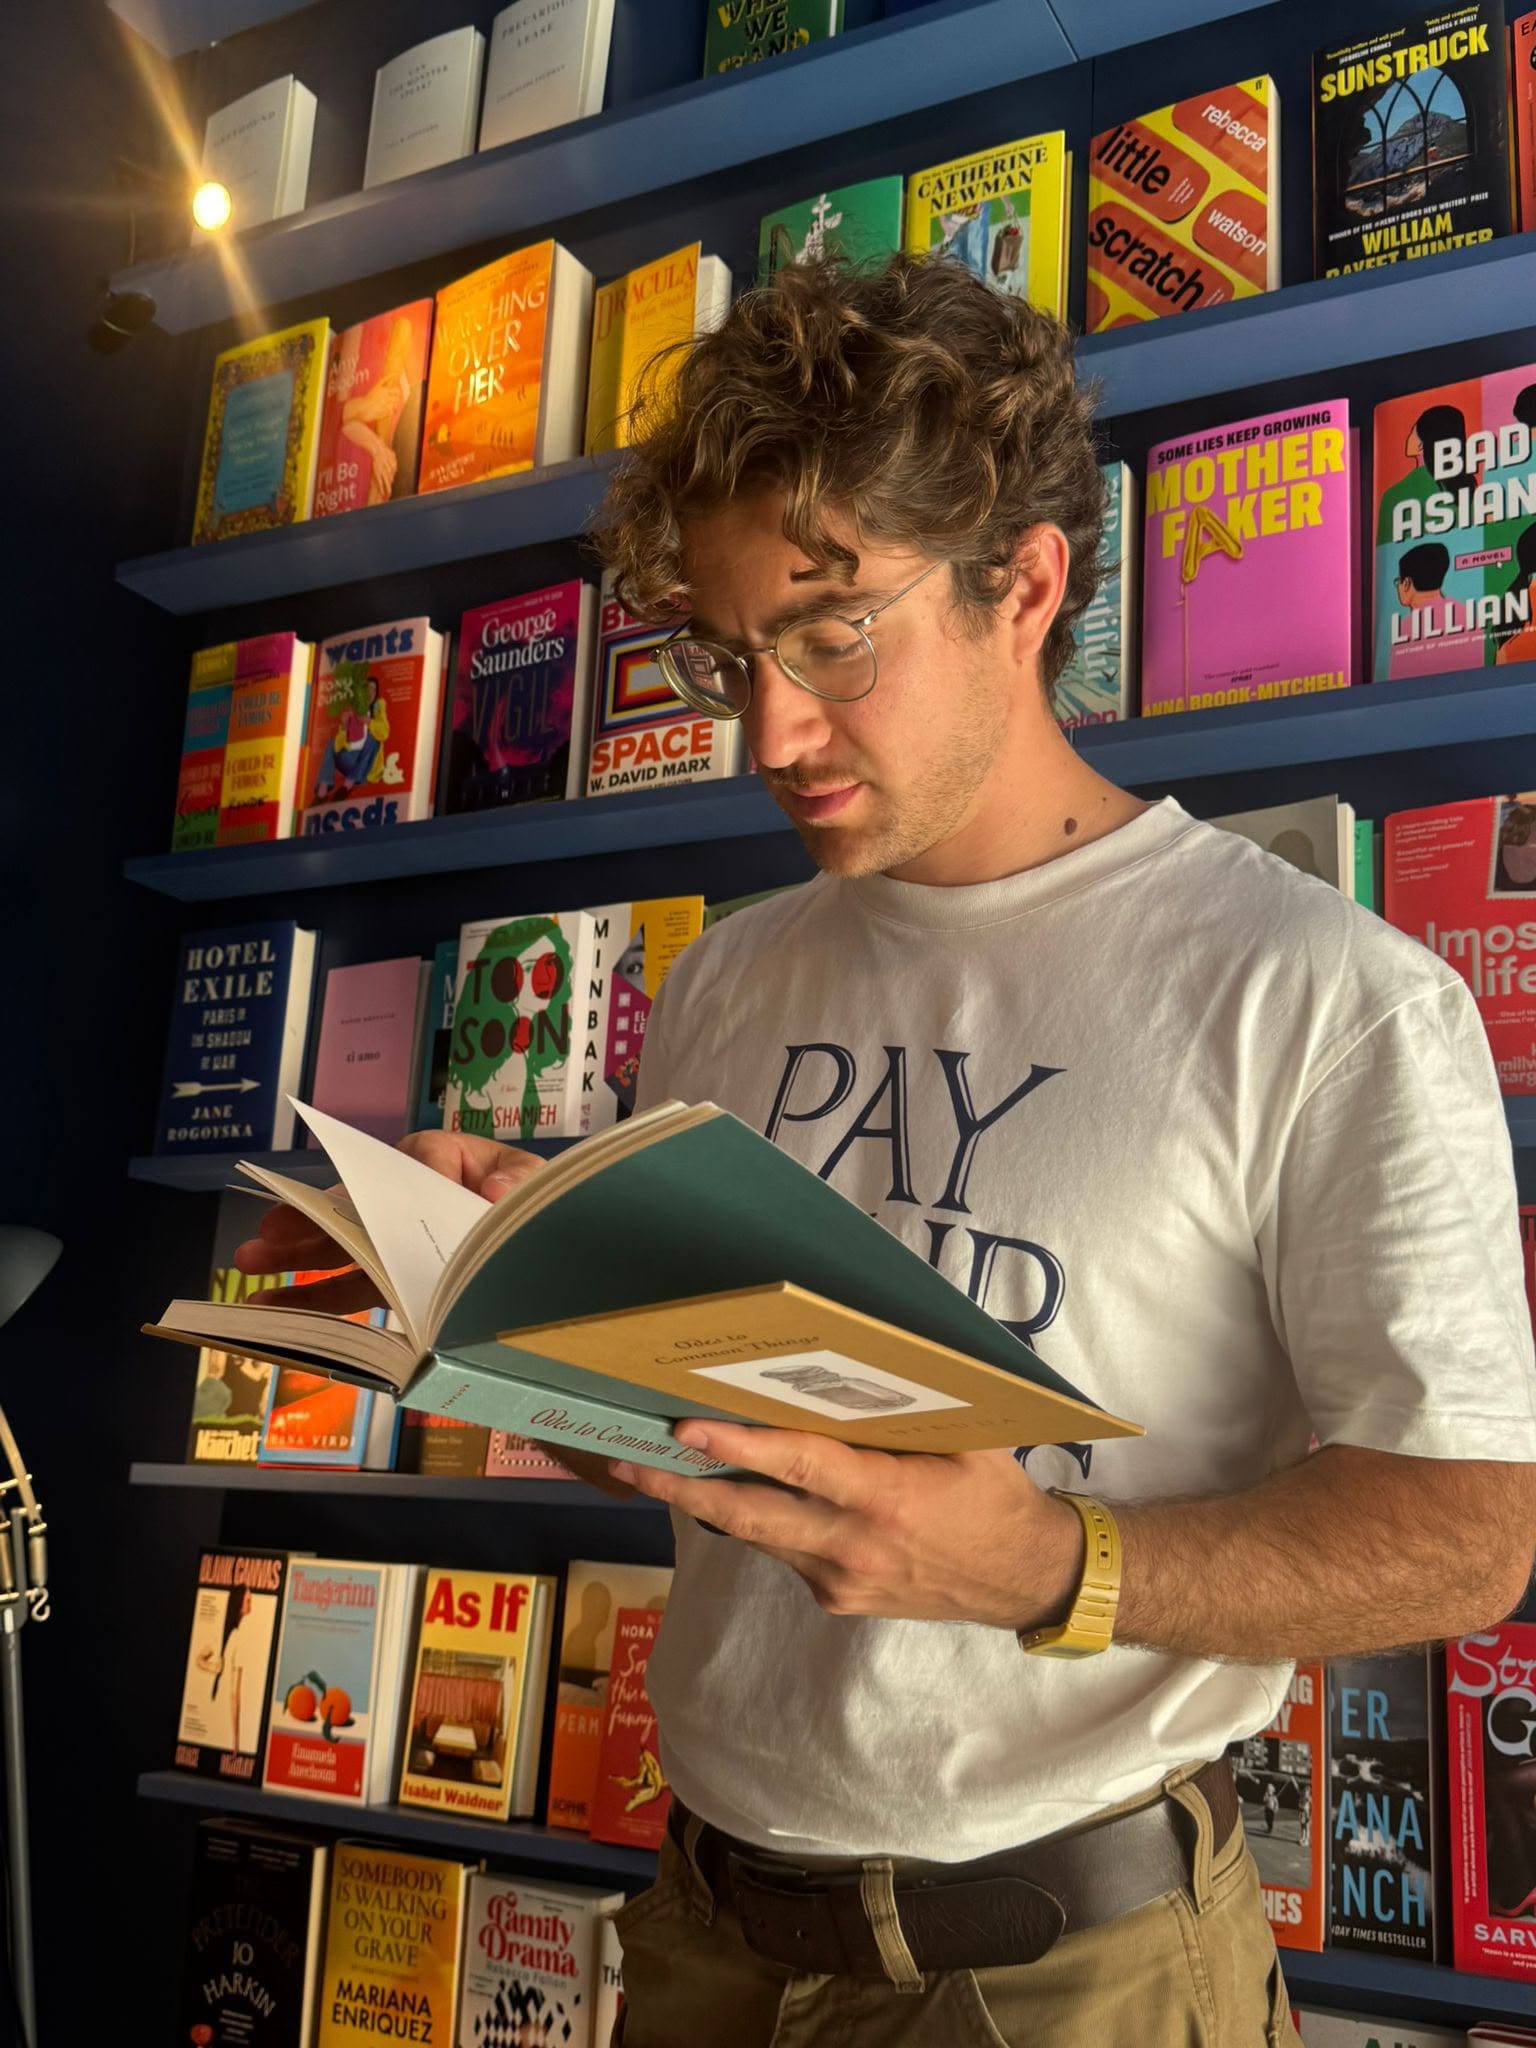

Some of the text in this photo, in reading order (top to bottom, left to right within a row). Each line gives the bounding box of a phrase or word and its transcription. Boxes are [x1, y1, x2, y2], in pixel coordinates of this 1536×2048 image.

[745, 5, 788, 45] WE
[1320, 23, 1490, 103] SUNSTRUCK
[1201, 104, 1267, 152] rebecca
[918, 147, 1048, 199] CATHERINE
[1096, 125, 1171, 195] little
[930, 167, 1034, 214] NEWMAN
[1207, 208, 1268, 256] watson
[1362, 211, 1453, 255] WILLIAM
[1088, 217, 1205, 312] scratch
[449, 319, 523, 377] OVER
[453, 365, 505, 415] HER
[1157, 410, 1331, 464] SOME LIES KEEP GROWING
[1434, 422, 1532, 482] BAD
[1146, 428, 1346, 518] MOTHER
[315, 483, 358, 512] Right
[1472, 551, 1507, 564] NOVEL
[481, 606, 557, 650] George
[1391, 588, 1531, 646] LILLIAN
[325, 626, 415, 668] wants
[469, 634, 565, 681] Saunders
[1190, 670, 1348, 711] BROOK-MITCHELL
[590, 720, 714, 775] SPACE
[589, 756, 712, 793] W. DAVID MARX
[304, 797, 399, 838] needs
[187, 940, 276, 972] HOTEL
[182, 971, 274, 1004] EXILE
[467, 952, 565, 1004] TOO
[203, 1009, 235, 1026] PARIS
[582, 918, 610, 1092] MINBAK
[206, 1029, 252, 1049] SHADOW
[452, 1003, 570, 1066] SOON
[212, 1054, 237, 1072] WAR
[167, 1124, 254, 1142] ROGOYSKA
[191, 1104, 233, 1121] JANE
[452, 1104, 557, 1132] BETTY SHAMIEH
[763, 1042, 1068, 1214] PAY
[654, 1335, 821, 1366] Common Things
[674, 1333, 748, 1350] Odes to
[530, 1408, 573, 1431] Odes
[574, 1420, 595, 1437] to
[596, 1424, 672, 1456] Common
[233, 1557, 283, 1590] CANVAS
[424, 1577, 530, 1633] As If
[620, 1624, 655, 1640] NORA
[1449, 1632, 1536, 1698] Str
[558, 1711, 600, 1736] PERM
[608, 1704, 659, 1743] funny
[397, 1780, 504, 1812] Isabel Waidner
[341, 1856, 447, 1894] SOMEBODY
[336, 1879, 447, 1921] IS WALKING
[486, 1891, 576, 1951] Family
[344, 1908, 433, 1944] ON YOUR
[1352, 1927, 1427, 1949] TIMES BESTSELLER
[1474, 1922, 1536, 1949] SARV
[354, 1934, 419, 1968] GRAVE
[478, 1922, 580, 1979] Drama
[203, 1971, 277, 2018] HARKIN
[602, 1965, 622, 1987] TH
[335, 1978, 433, 2019] MARIANA
[331, 2002, 433, 2045] ENRIQUEZ
